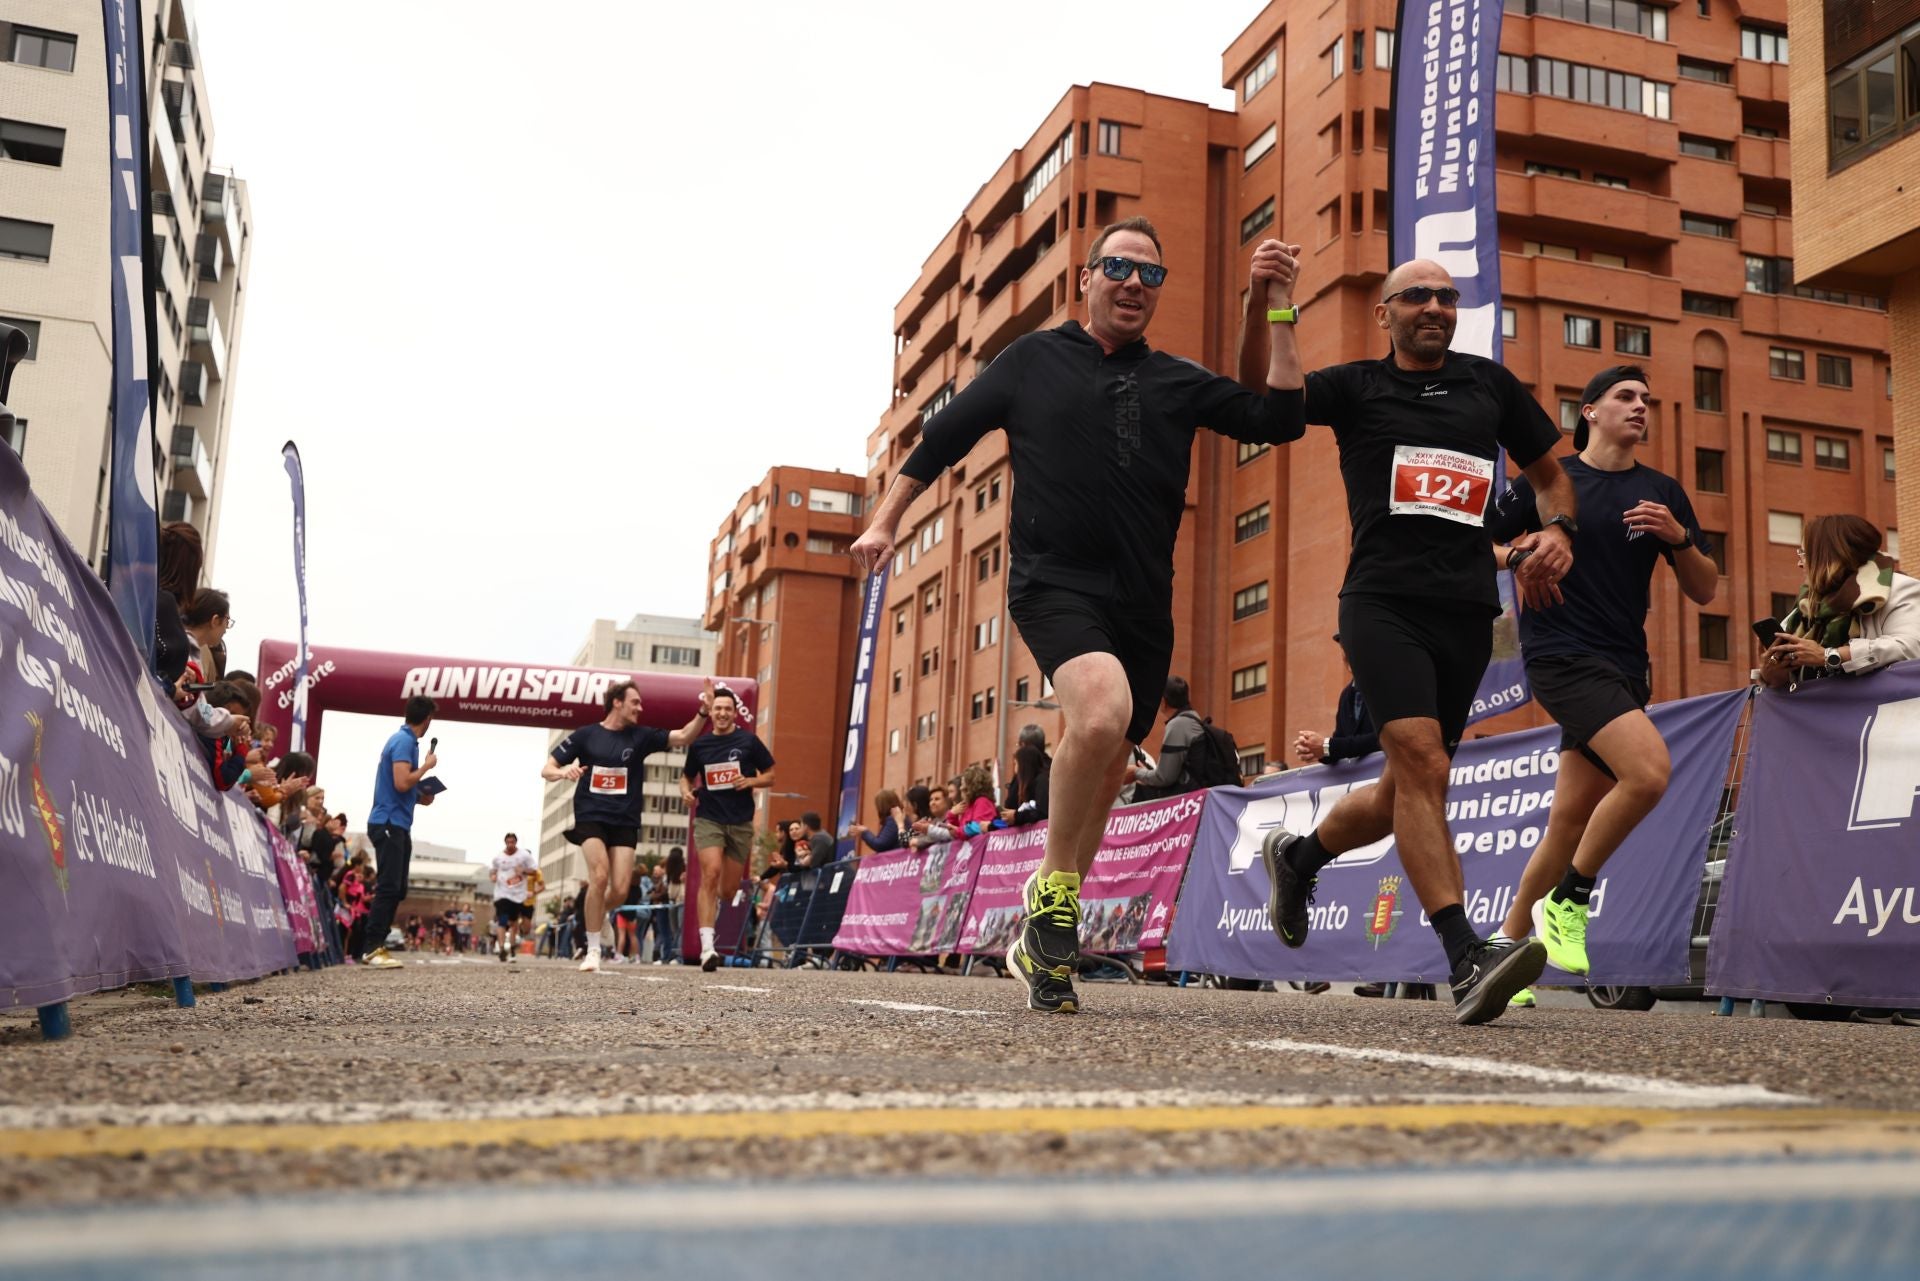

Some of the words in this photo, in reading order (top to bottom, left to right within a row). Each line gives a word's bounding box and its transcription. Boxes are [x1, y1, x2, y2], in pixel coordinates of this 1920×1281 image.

[1416, 0, 1442, 200] Fundación
[1407, 458, 1430, 466] VIDAL
[1433, 460, 1484, 475] MATARRANZ
[1415, 452, 1433, 460] XXIX
[1435, 454, 1476, 467] MEMORIAL
[1415, 472, 1471, 505] 124
[459, 701, 574, 718] www.runvasport.es
[602, 776, 616, 788] 25
[712, 771, 733, 784] 167
[83, 791, 157, 879] Valladolid
[1123, 843, 1151, 860] EVENTOS
